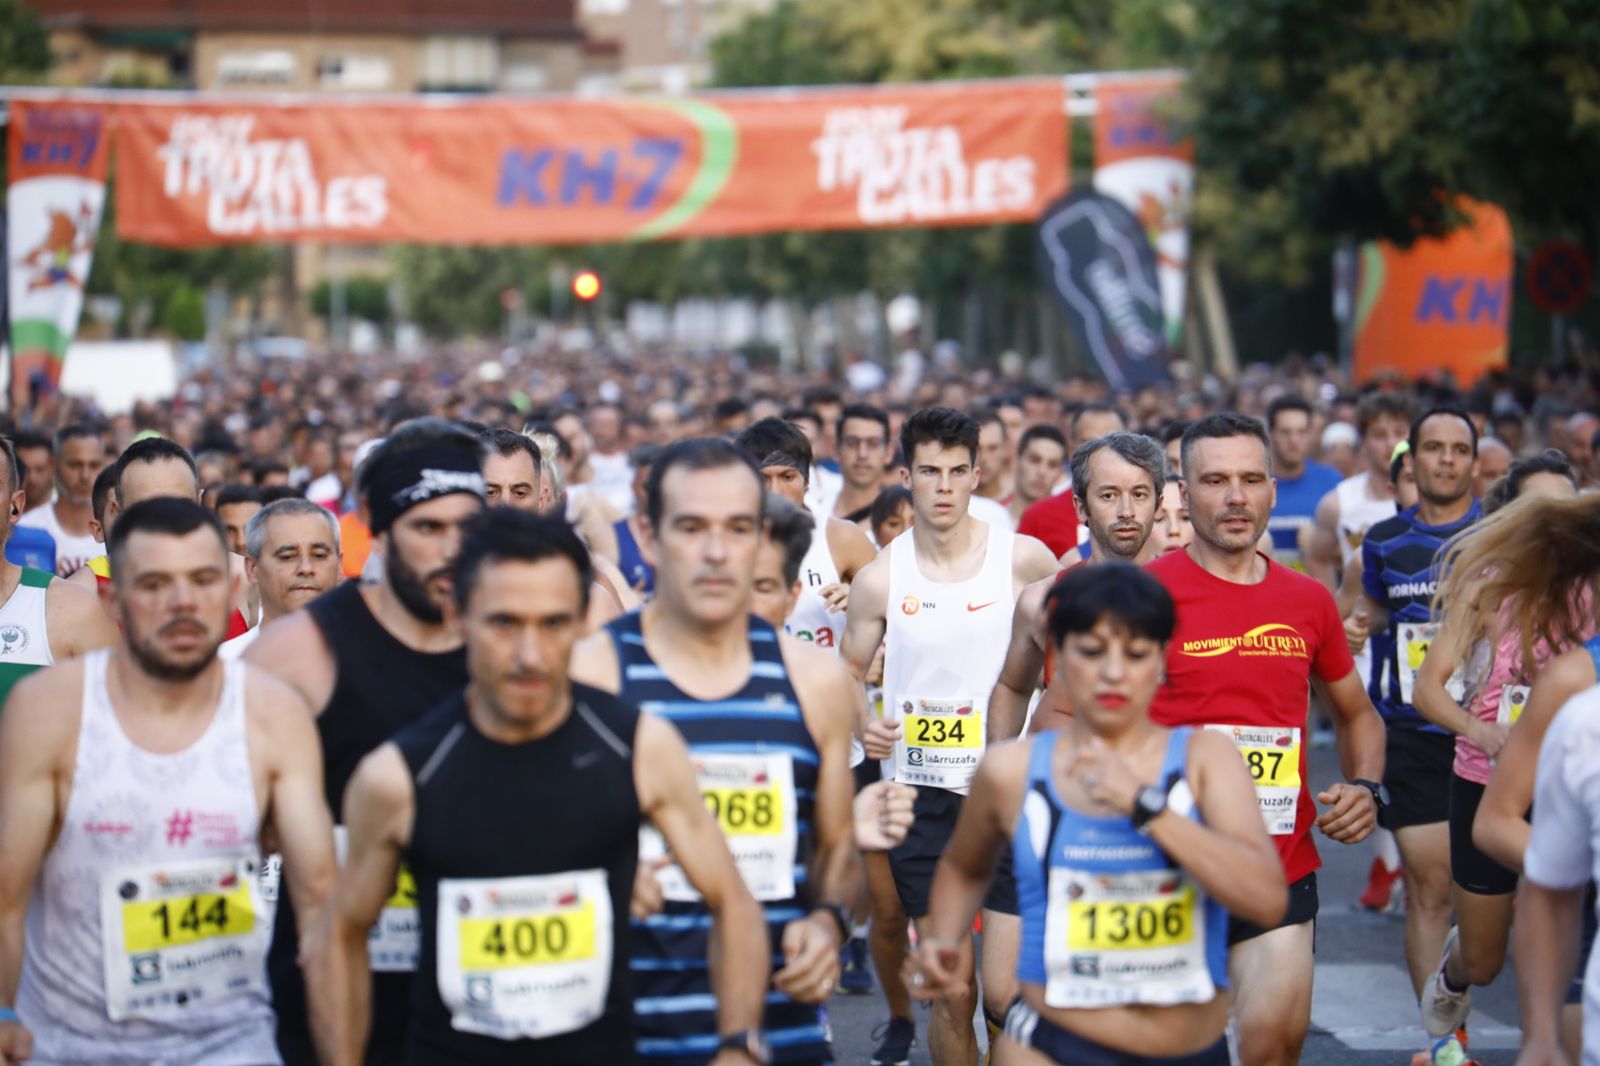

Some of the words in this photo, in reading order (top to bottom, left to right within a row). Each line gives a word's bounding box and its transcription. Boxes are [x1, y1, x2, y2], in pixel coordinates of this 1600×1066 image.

[917, 718, 965, 743] 234
[925, 754, 977, 764] laArruzafa
[152, 896, 230, 940] 144
[1082, 903, 1184, 943] 1306
[481, 916, 570, 961] 400
